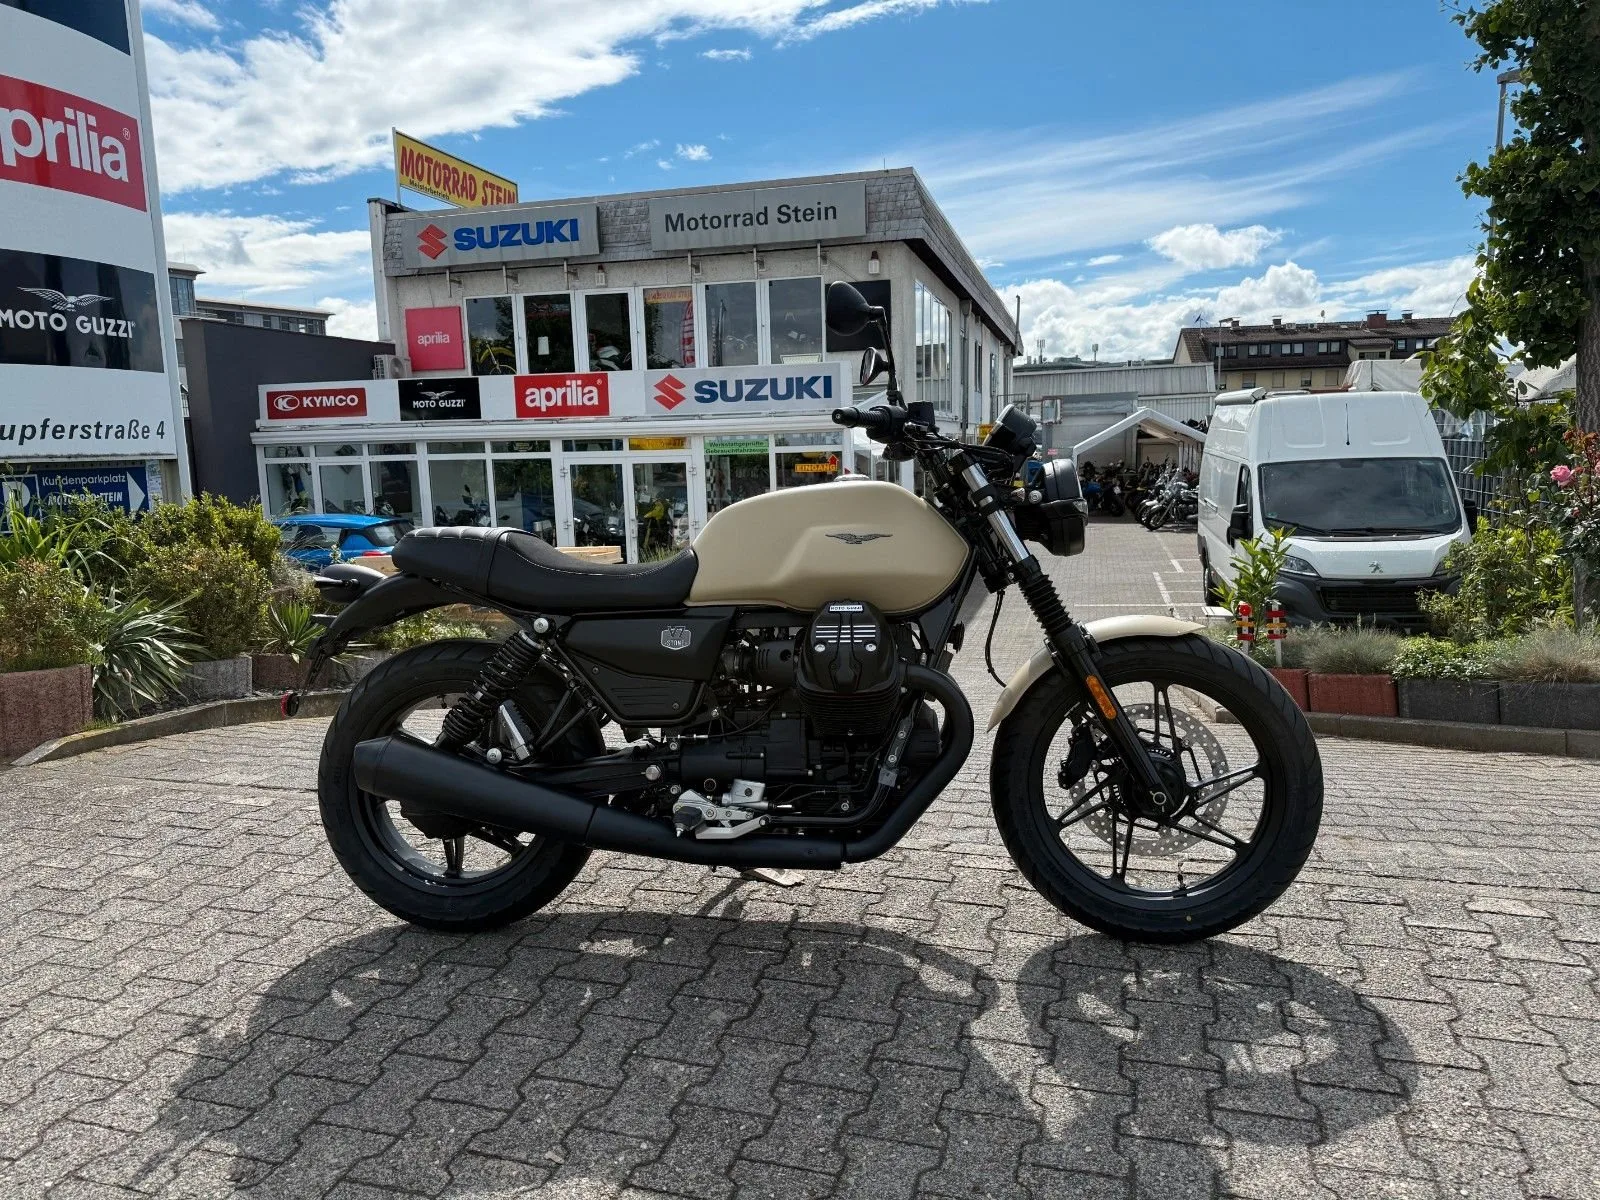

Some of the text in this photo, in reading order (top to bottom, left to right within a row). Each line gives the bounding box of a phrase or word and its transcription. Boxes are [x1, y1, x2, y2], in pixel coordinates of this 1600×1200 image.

[0, 106, 129, 183] prilia
[400, 146, 516, 206] MOTORRAD STEIN
[409, 179, 450, 200] Meisterbetrieb
[664, 202, 837, 233] Motorrad Stein
[453, 218, 579, 251] SUZUKI
[0, 309, 133, 339] MOTO GUZZI
[417, 331, 450, 347] aprilia
[302, 395, 359, 408] KYMCO
[525, 379, 599, 412] aprilia
[694, 375, 832, 403] SUZUKI
[412, 399, 465, 409] MOTO GUZZI
[0, 417, 165, 446] upferstraße 4
[42, 473, 126, 486] Kundenparkplatz
[795, 463, 836, 471] EINGANG
